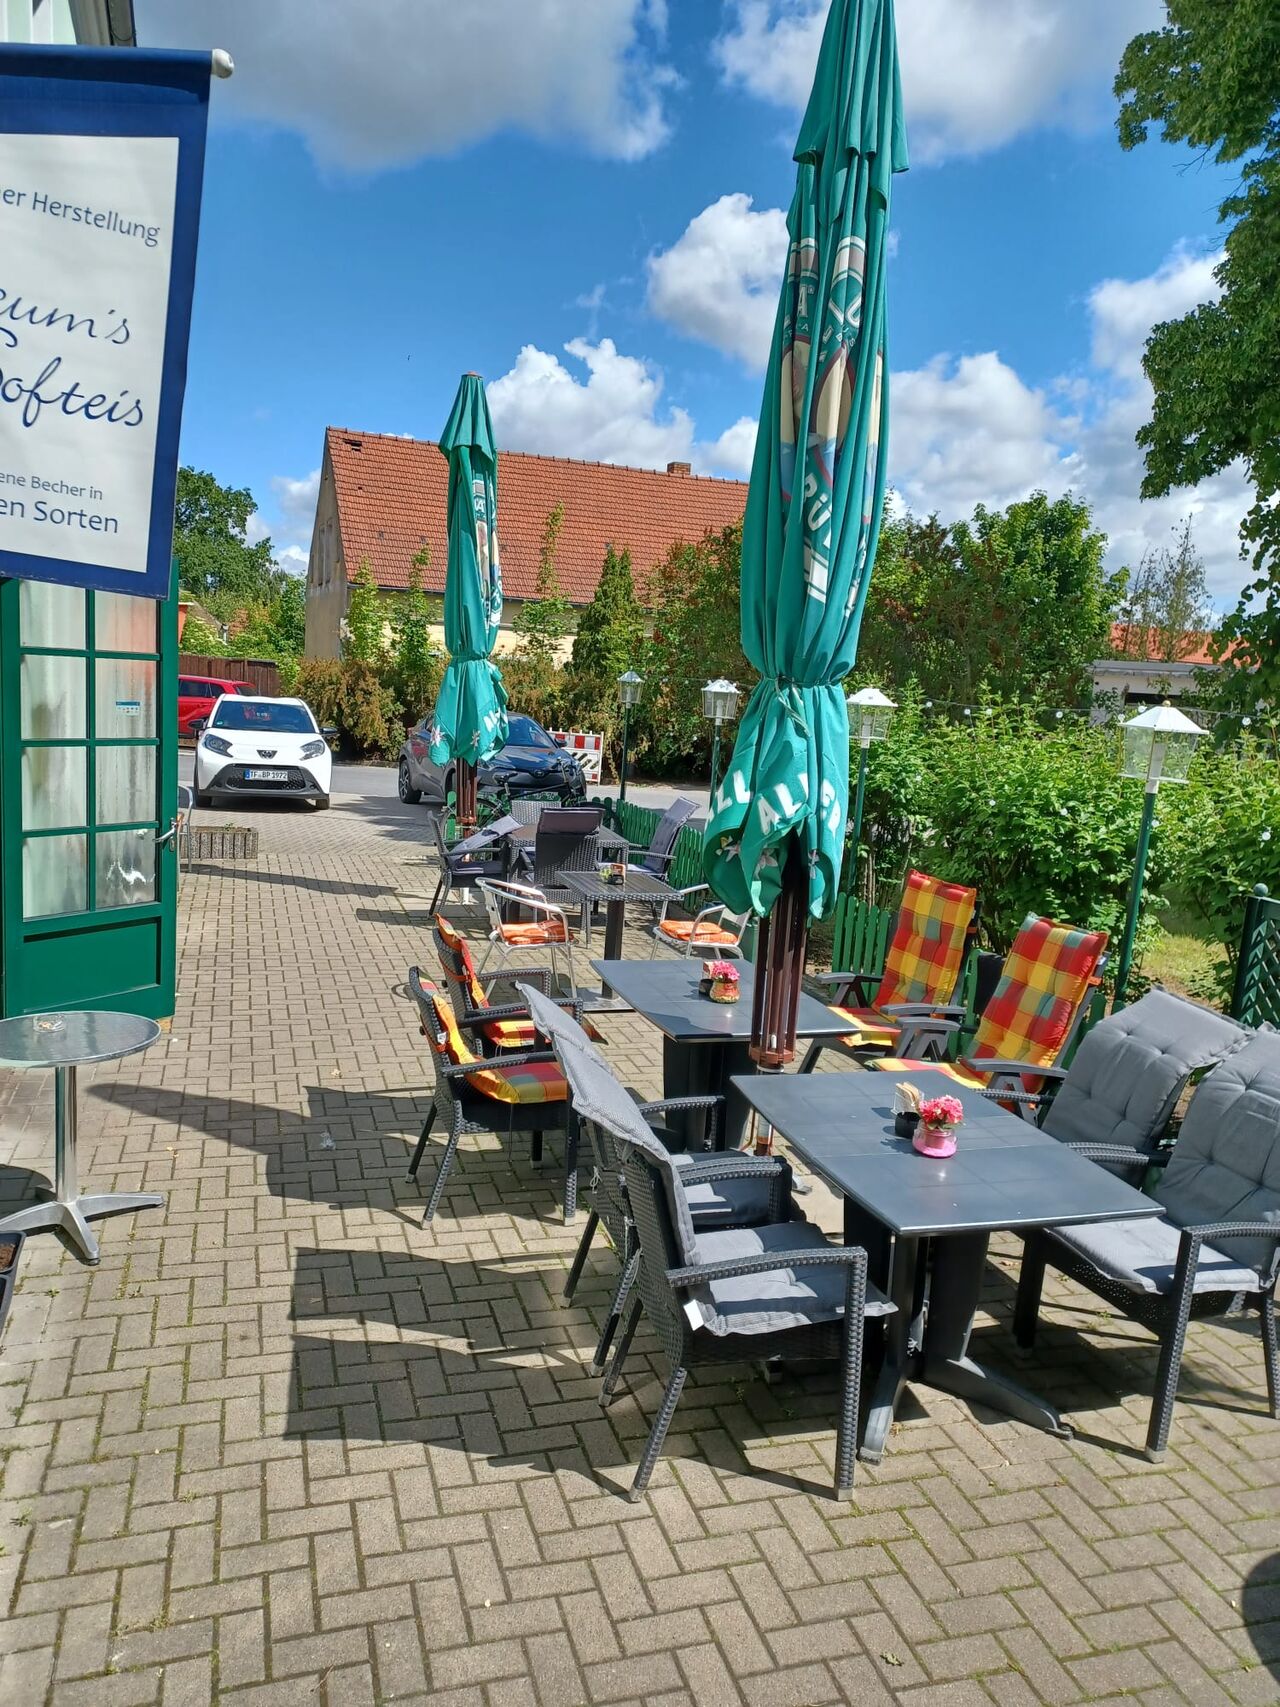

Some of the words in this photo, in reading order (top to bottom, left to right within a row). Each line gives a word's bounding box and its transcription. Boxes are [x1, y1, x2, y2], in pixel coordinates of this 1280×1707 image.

[32, 191, 161, 247] Herstellung
[31, 475, 87, 497] Becher
[89, 485, 103, 500] in
[33, 500, 118, 534] Sorten
